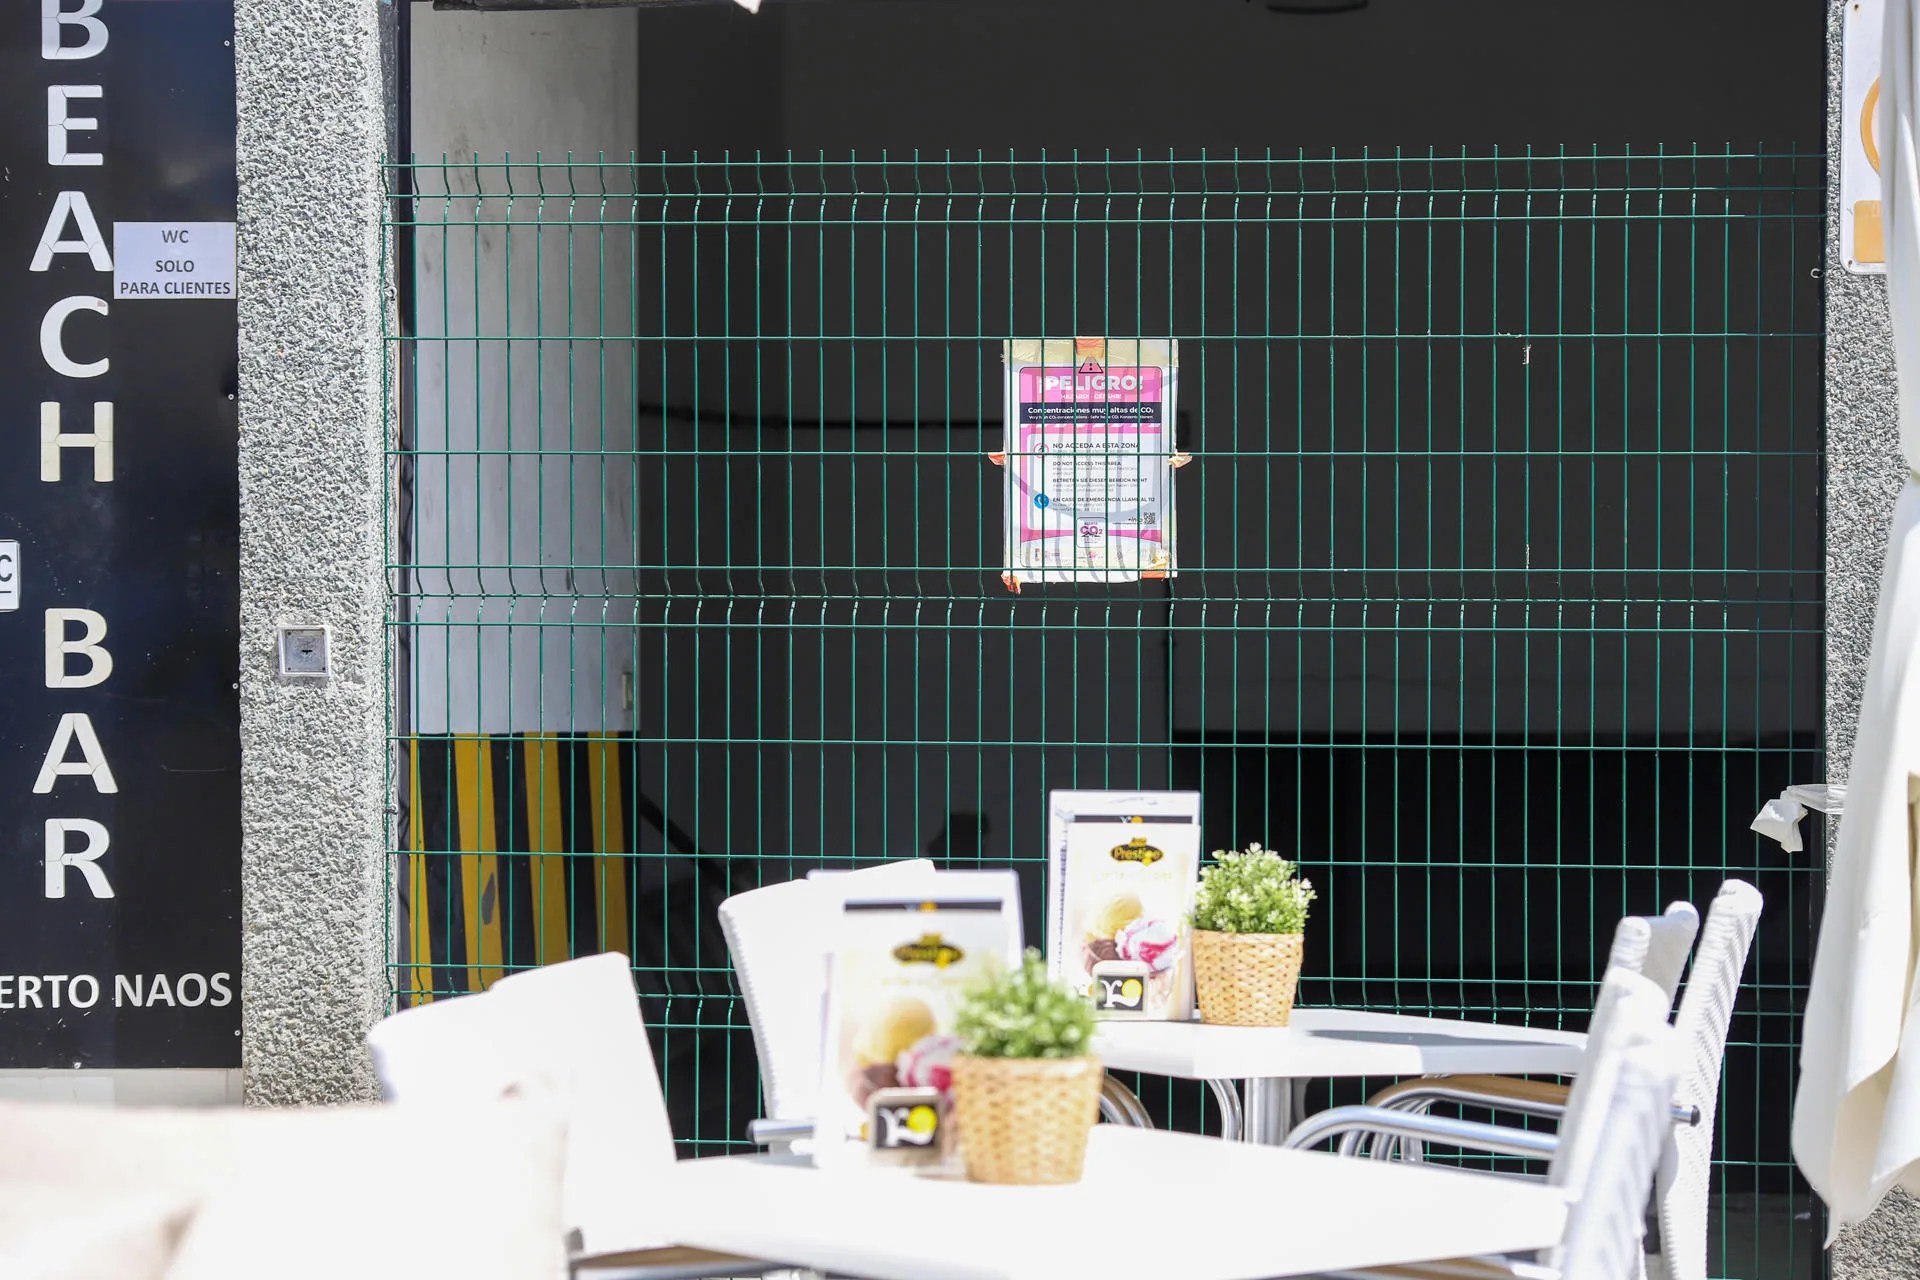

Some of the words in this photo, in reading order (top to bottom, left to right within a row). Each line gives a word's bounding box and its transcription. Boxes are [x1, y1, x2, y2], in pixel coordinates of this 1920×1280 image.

[29, 0, 114, 482] BEACH
[161, 229, 189, 244] WC
[155, 259, 195, 273] SOLO
[120, 281, 161, 295] PARA
[163, 281, 231, 295] CLIENTES
[1109, 406, 1129, 414] altas
[32, 608, 119, 899] BAR
[114, 972, 233, 1008] NAOS
